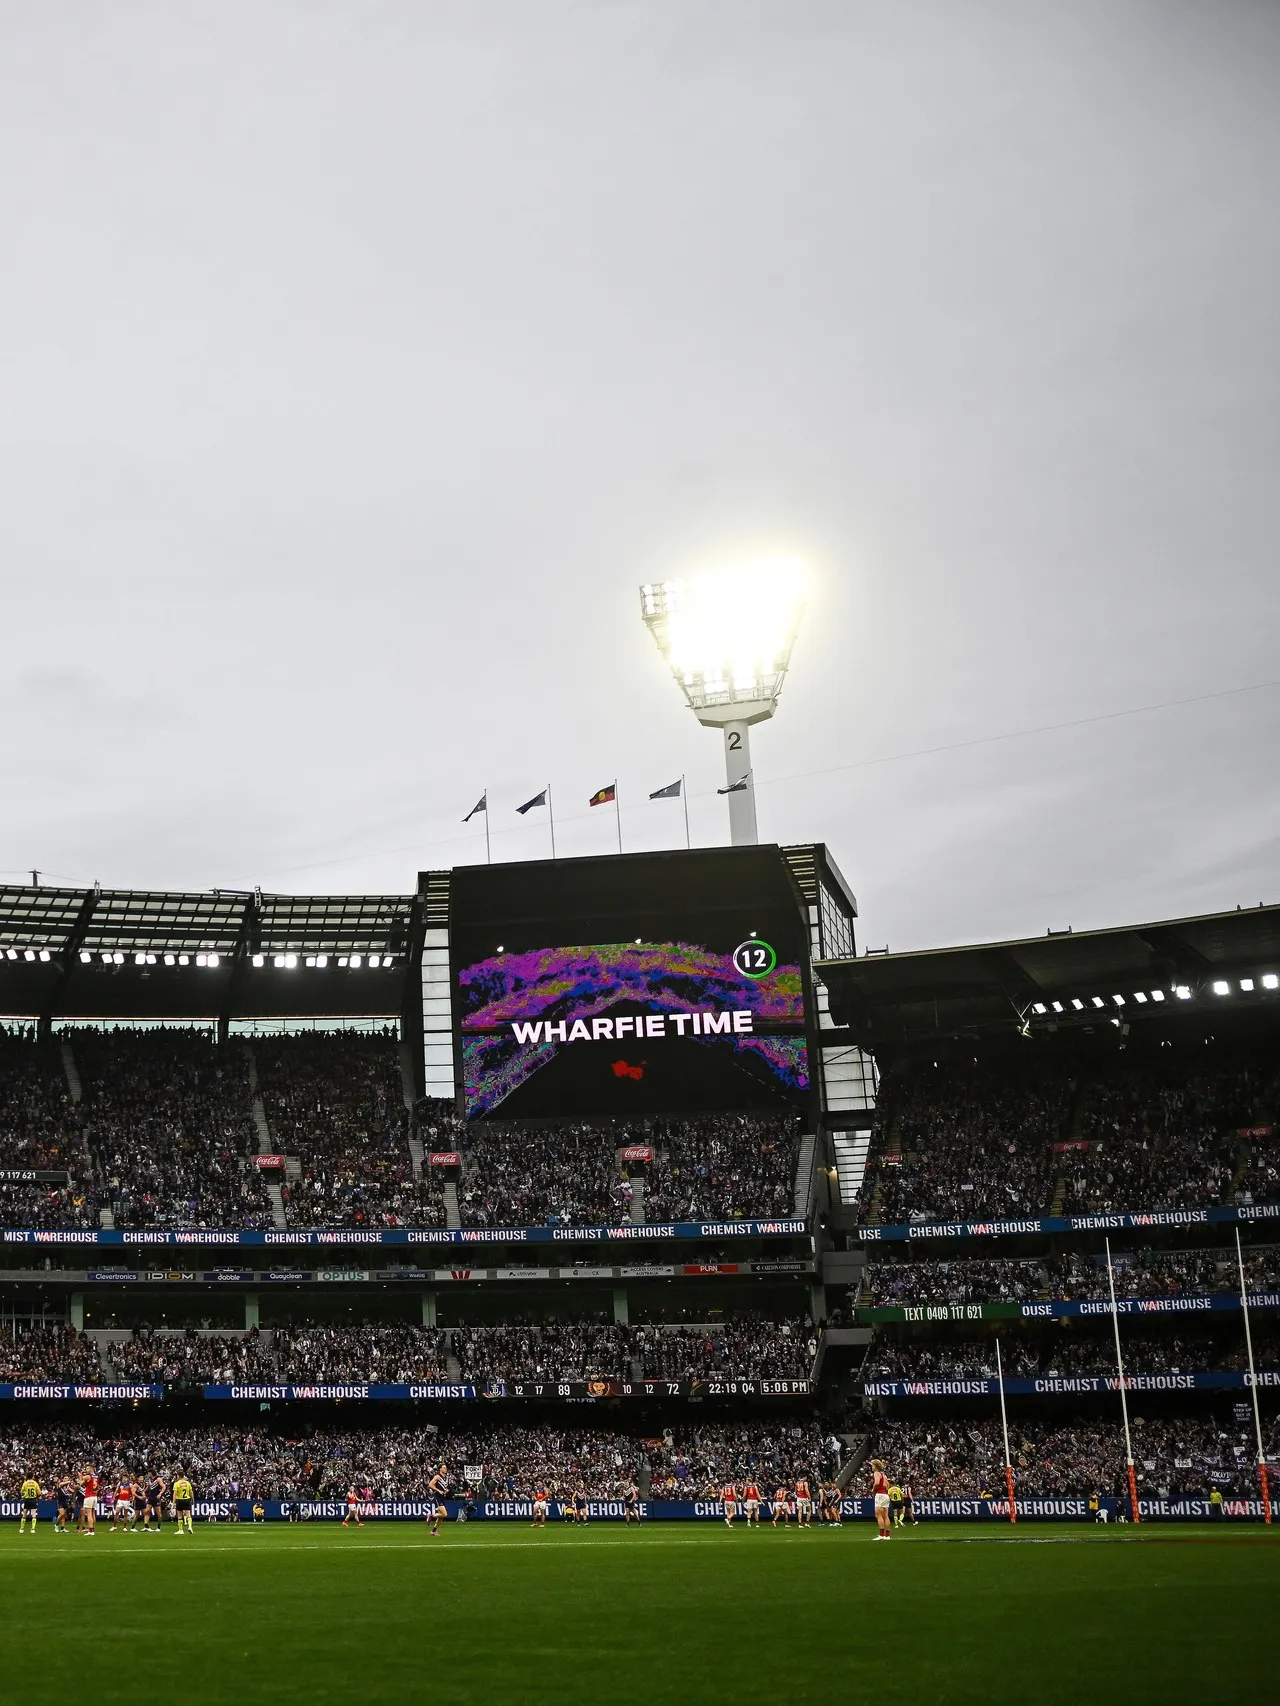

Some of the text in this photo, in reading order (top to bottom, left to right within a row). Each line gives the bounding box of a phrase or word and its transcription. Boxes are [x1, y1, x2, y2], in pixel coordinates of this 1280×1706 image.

[728, 731, 742, 750] 2
[742, 950, 767, 969] 12
[511, 1010, 753, 1044] WHARFIE TIME
[7, 1171, 20, 1179] 117
[1072, 1212, 1207, 1228] CHEMIST WAREHOUSE
[554, 1227, 674, 1238] CHEMIST WAREHOUSE
[701, 1223, 752, 1236] CHEMIST
[909, 1222, 1040, 1236] CHEMIST WAREHOUSE
[5, 1232, 97, 1241] MIST WAREHOUSE
[124, 1233, 239, 1242] CHEMIST WAREHOUSE
[265, 1233, 382, 1242] CHEMIST WAREHOUSE
[408, 1231, 526, 1241] CHEMIST WAREHOUSE
[218, 1273, 240, 1281] dabble
[323, 1272, 364, 1281] OPTUS
[1023, 1306, 1052, 1315] OUSE
[1080, 1298, 1211, 1315] CHEMIST WAREHOUSE
[904, 1305, 982, 1321] TEXT 0409 117 621
[514, 1381, 807, 1395] 12 17 89 10 12 72 22:19 Q4 5:06 PM
[865, 1382, 988, 1395] MIST WAREHOUSE
[1035, 1376, 1194, 1391] CHEMIST WAREHOUSE
[14, 1387, 150, 1397] CHEMIST WAREHOUSE
[232, 1387, 368, 1398] CHEMIST WAREHOUSE
[410, 1387, 467, 1397] CHEMIST
[27, 1488, 35, 1497] 16
[182, 1489, 187, 1498] 2
